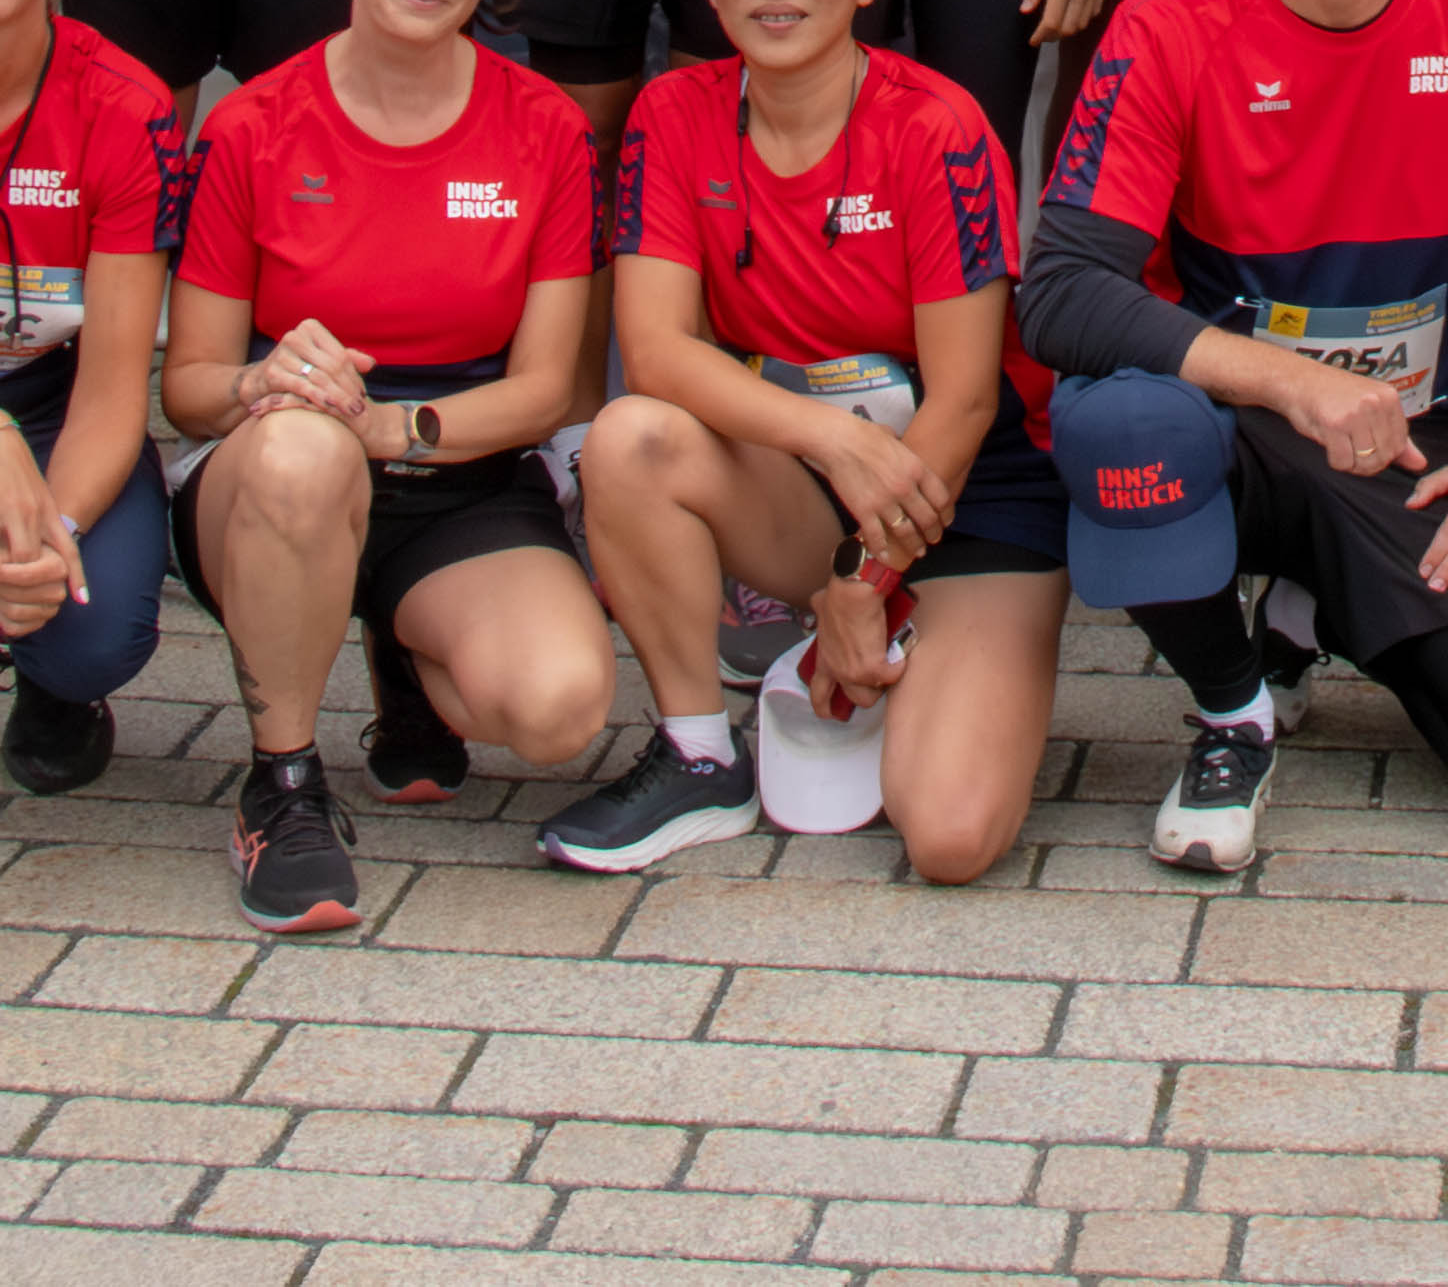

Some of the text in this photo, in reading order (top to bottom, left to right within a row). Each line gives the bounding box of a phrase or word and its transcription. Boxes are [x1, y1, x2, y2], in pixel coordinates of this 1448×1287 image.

[8, 186, 80, 209] BRUCK
[446, 199, 519, 220] BRUCK
[835, 210, 894, 233] RUCK
[1096, 461, 1164, 490] INNS'
[1097, 479, 1185, 511] BRUCK
